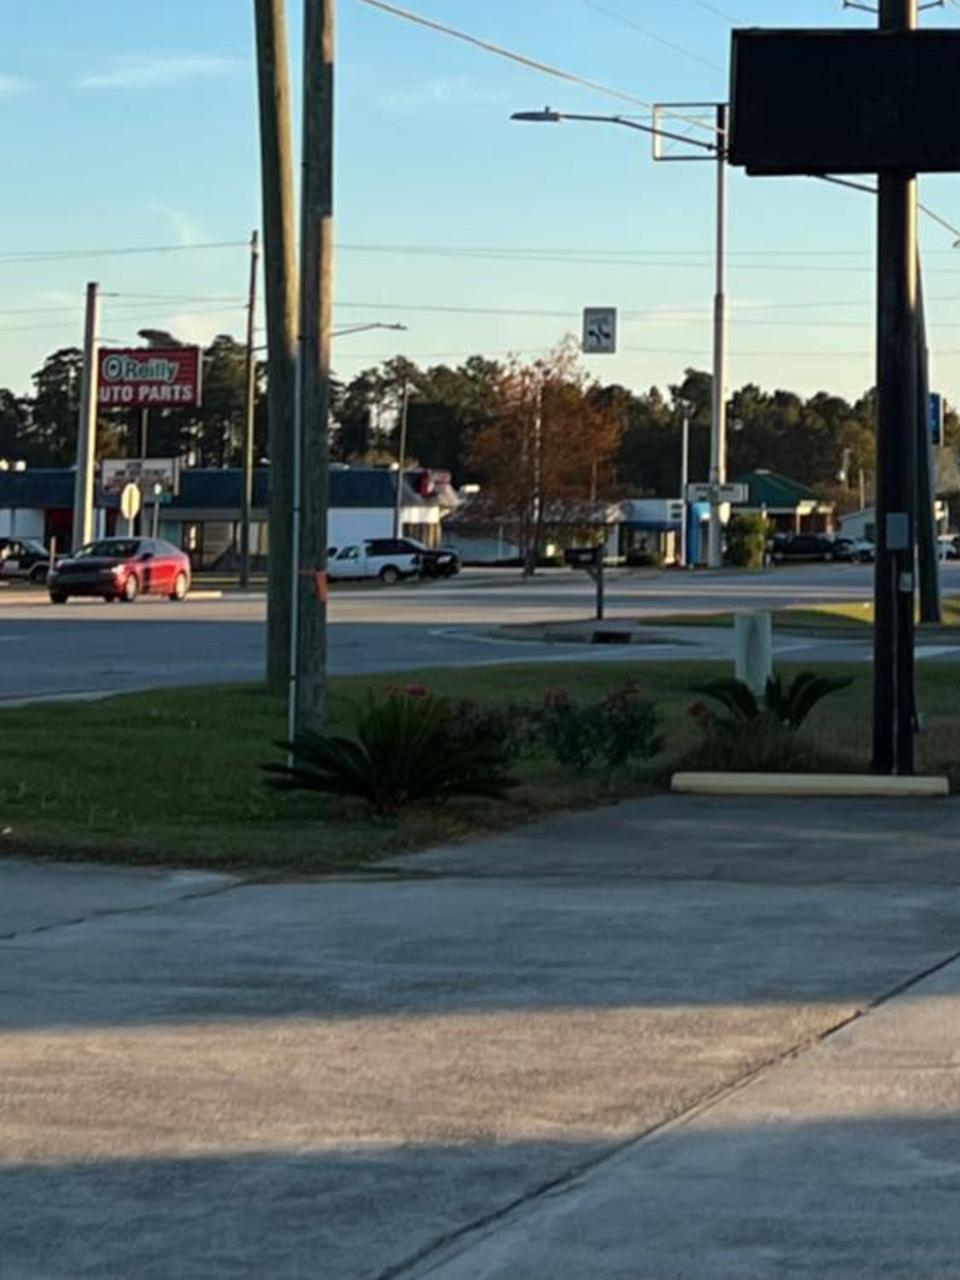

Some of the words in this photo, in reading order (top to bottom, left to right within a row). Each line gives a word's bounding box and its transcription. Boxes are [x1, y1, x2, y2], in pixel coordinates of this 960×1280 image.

[103, 355, 178, 382] O'Reilly
[100, 385, 133, 402] UTO
[138, 385, 193, 402] PARTS
